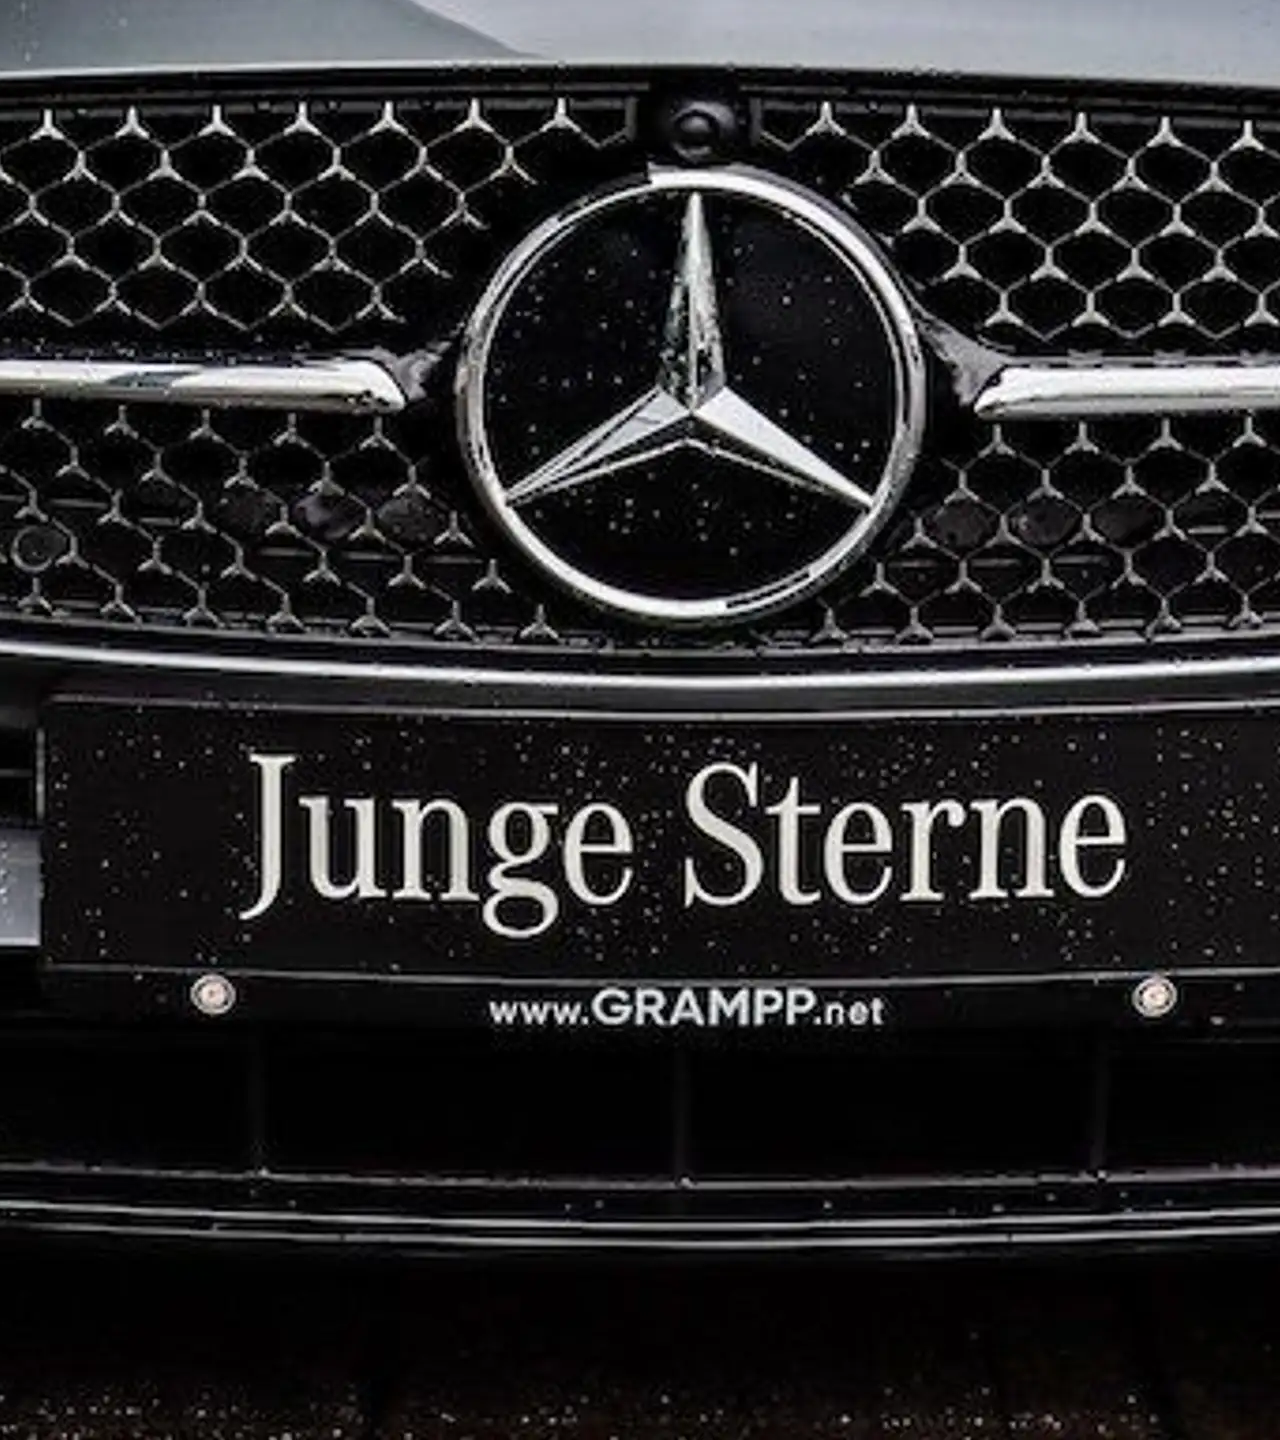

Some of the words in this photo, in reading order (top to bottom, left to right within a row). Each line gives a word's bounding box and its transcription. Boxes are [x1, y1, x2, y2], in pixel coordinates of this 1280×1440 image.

[238, 752, 634, 939] Junge
[683, 760, 1127, 908] Sterne
[488, 985, 885, 1027] www.GRAMPP.net
